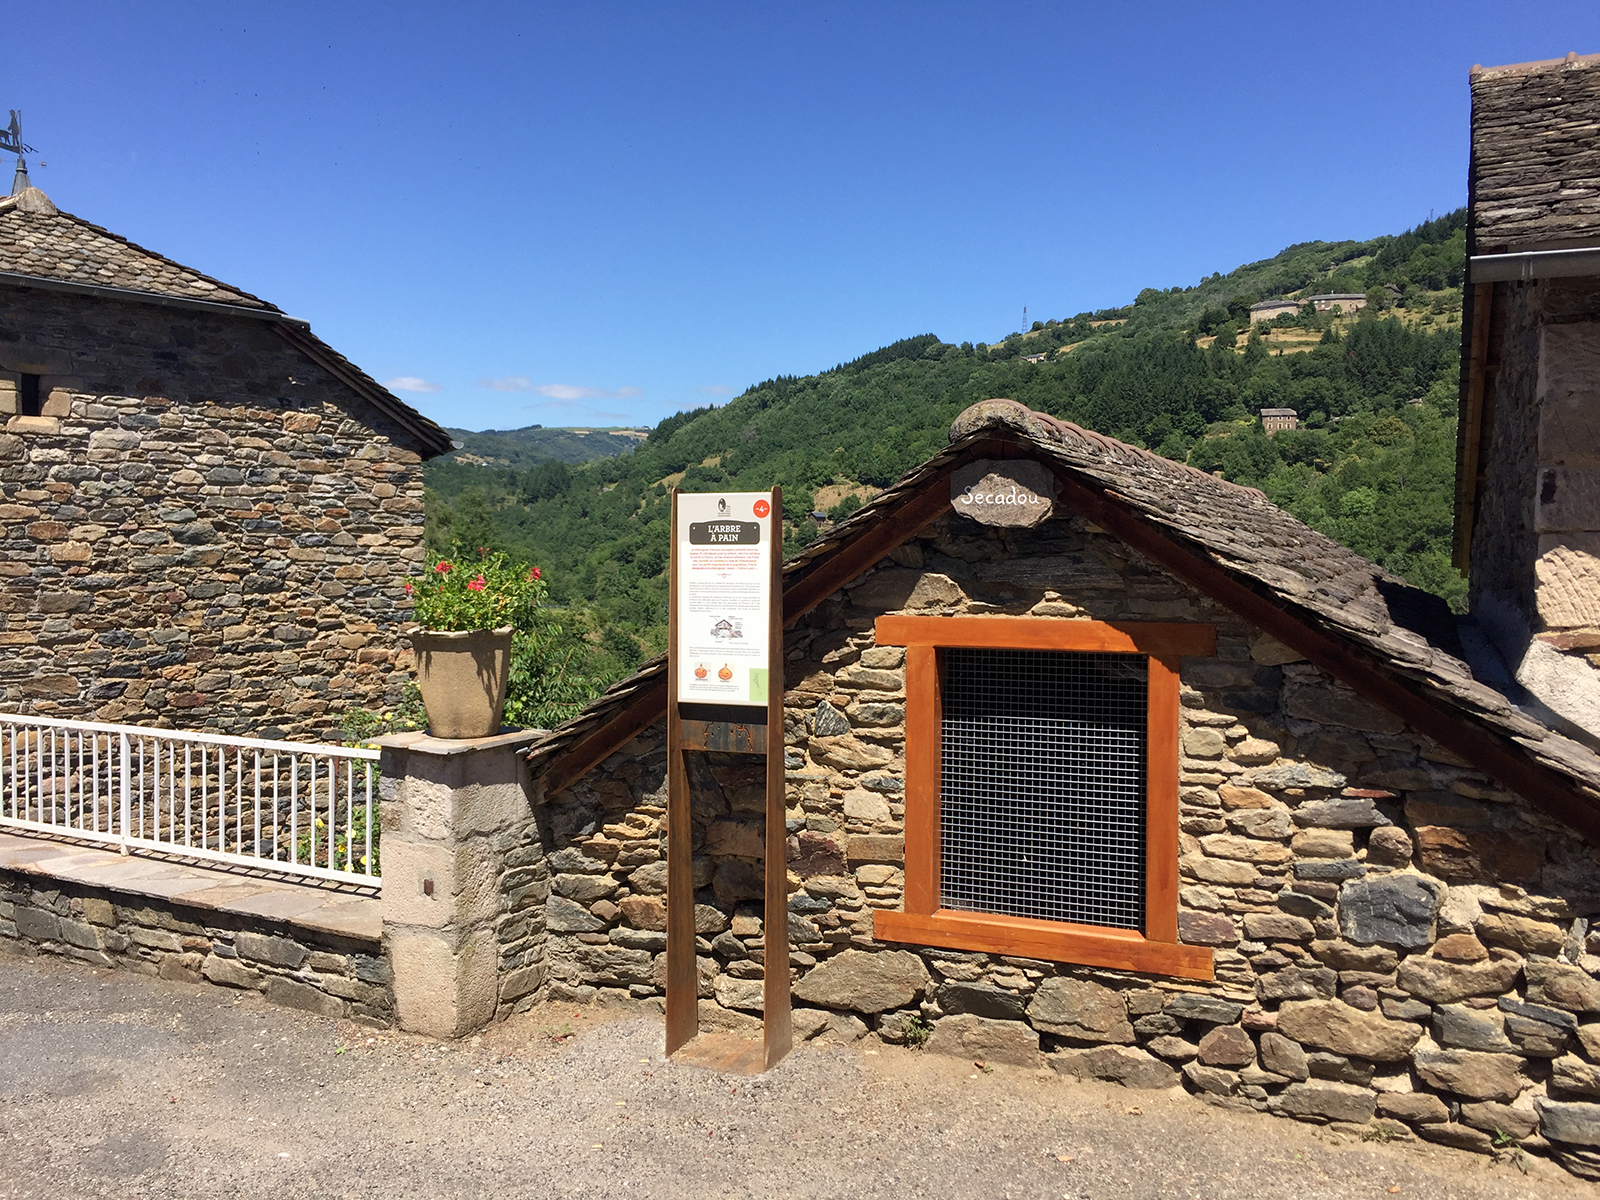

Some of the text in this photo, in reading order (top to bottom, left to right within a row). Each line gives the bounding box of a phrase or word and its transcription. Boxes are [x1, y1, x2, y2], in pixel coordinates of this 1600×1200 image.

[961, 485, 1039, 505] Secadou
[708, 525, 741, 533] L'ARBRE
[710, 531, 738, 542] À PAIN
